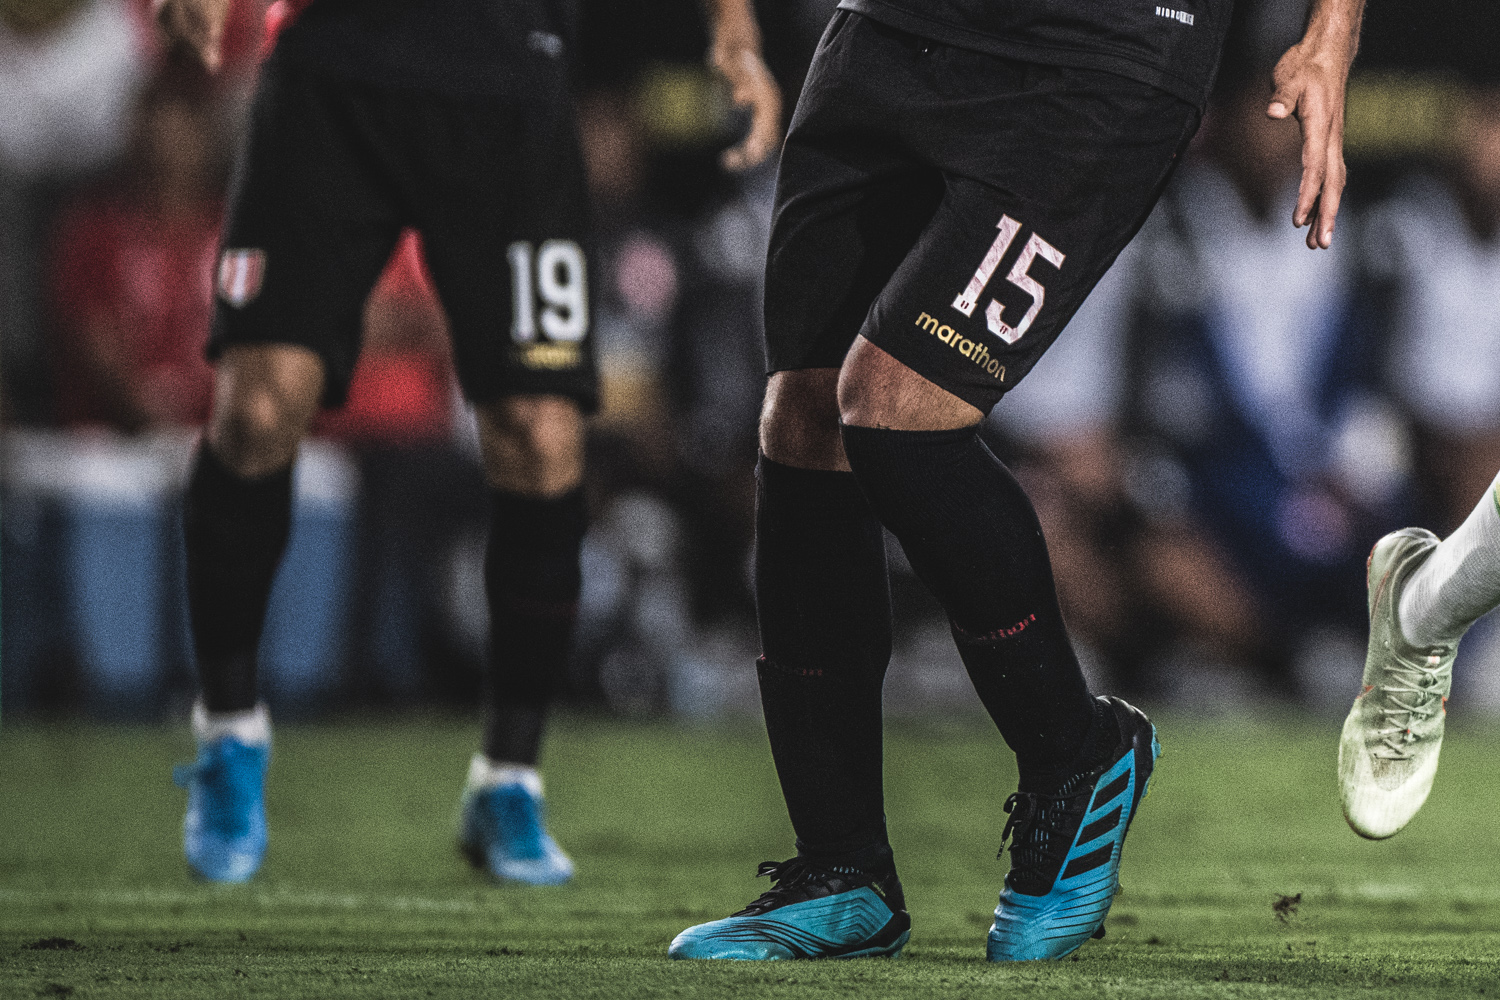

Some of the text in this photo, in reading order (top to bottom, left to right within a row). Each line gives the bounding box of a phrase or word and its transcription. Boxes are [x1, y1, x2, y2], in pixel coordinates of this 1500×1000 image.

[506, 238, 590, 343] 19
[951, 213, 1066, 345] 15
[914, 311, 1007, 382] marathon
